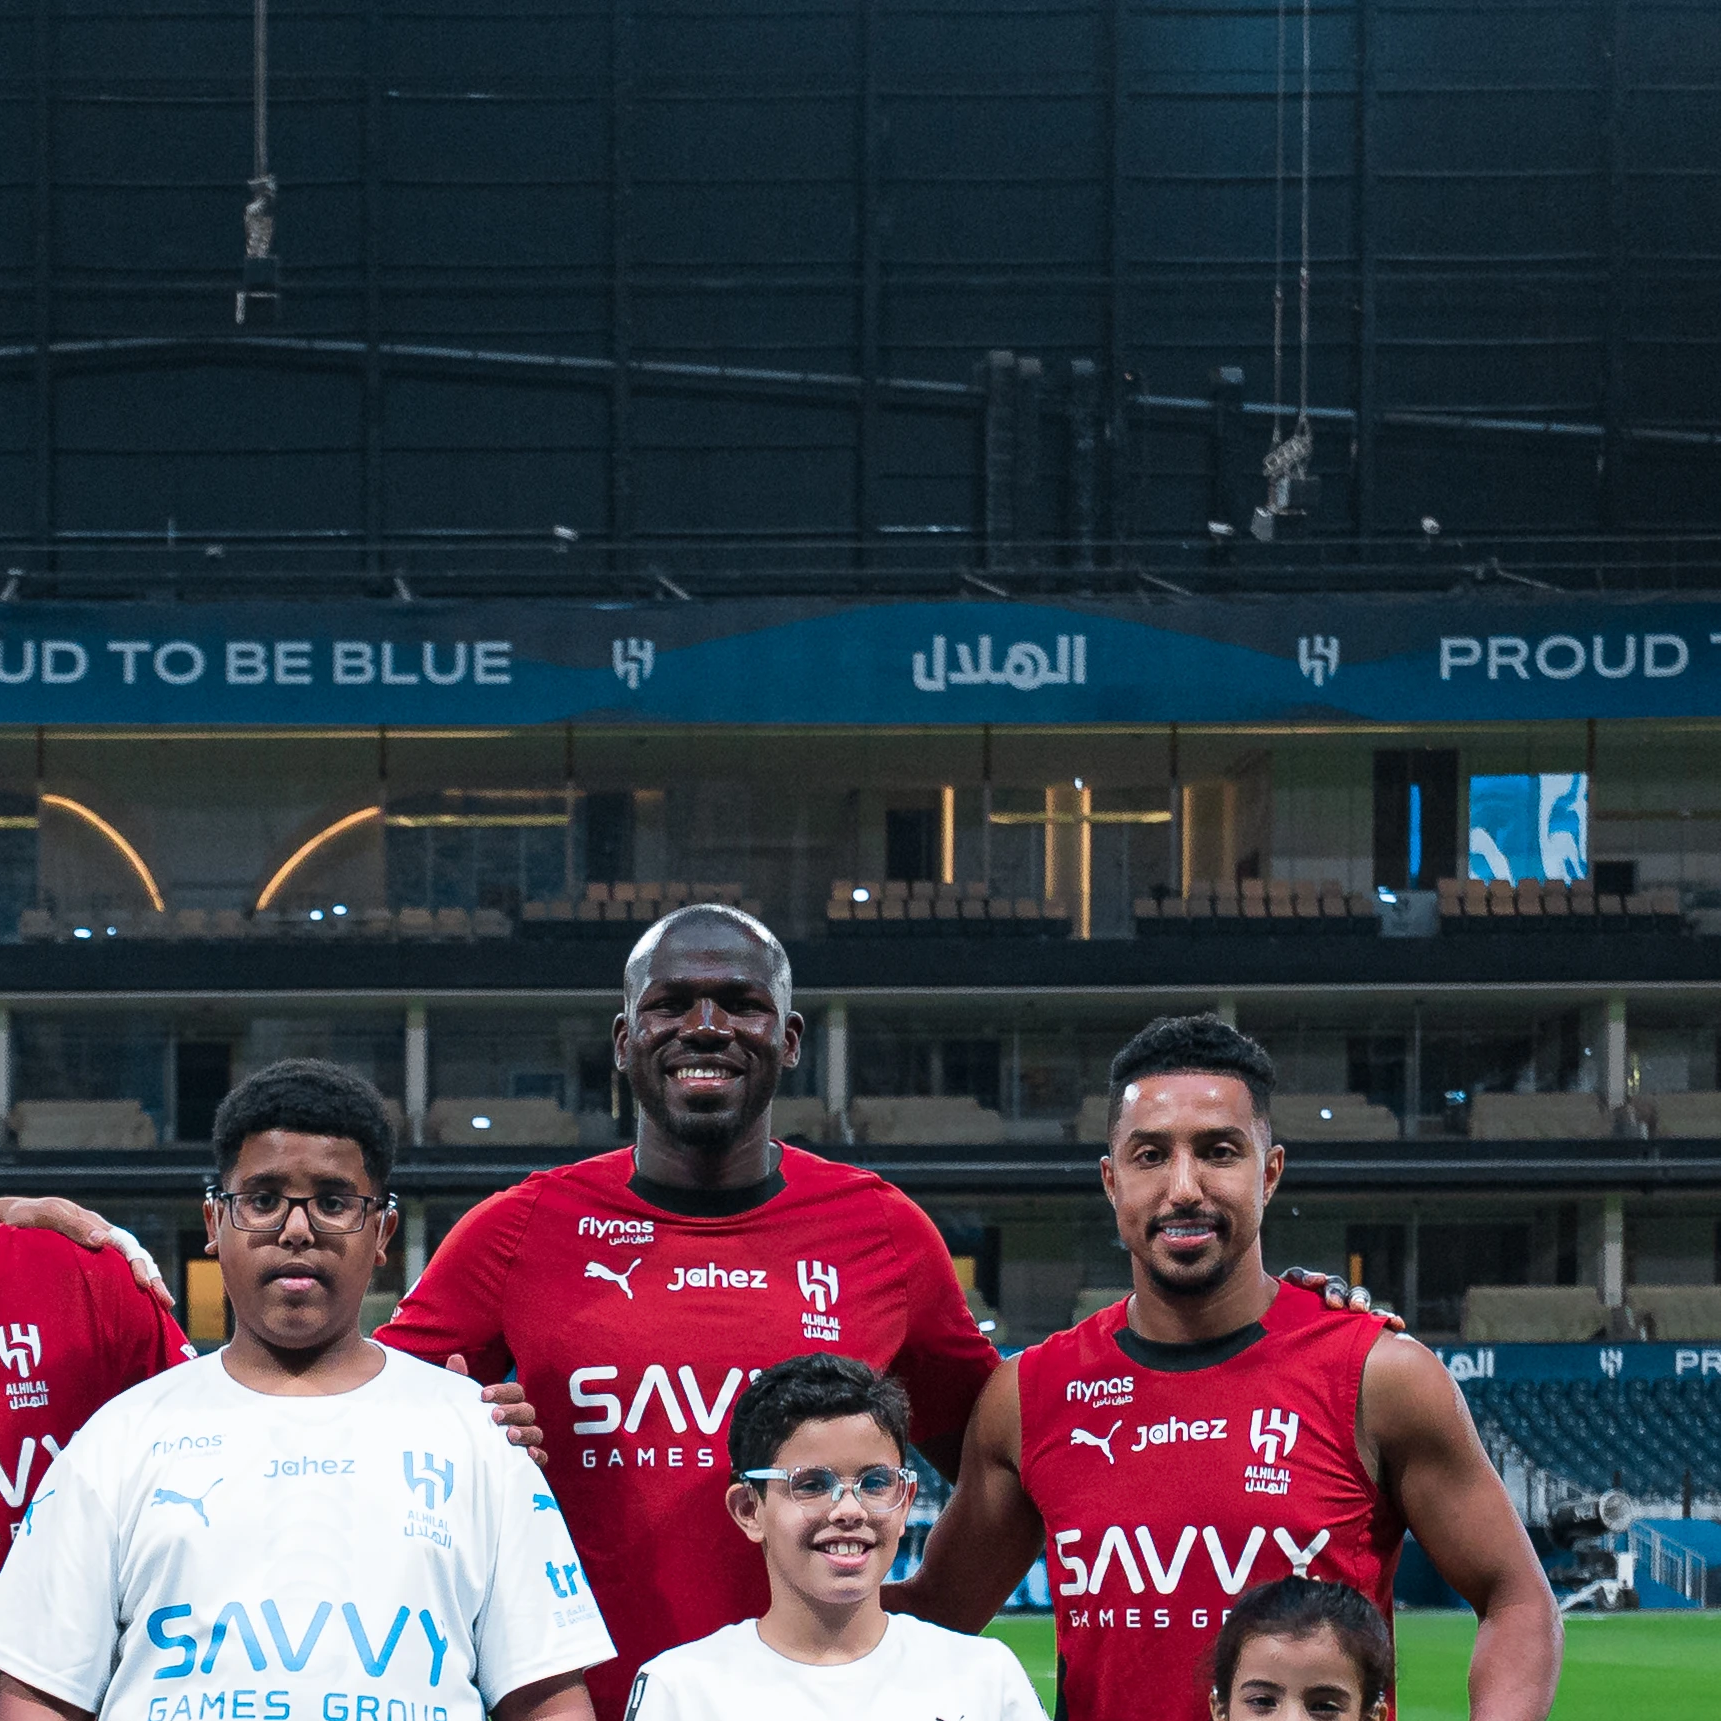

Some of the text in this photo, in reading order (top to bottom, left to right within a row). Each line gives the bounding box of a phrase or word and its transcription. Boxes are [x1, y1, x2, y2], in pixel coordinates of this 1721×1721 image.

[106, 639, 207, 686] TO
[225, 639, 314, 686] BE
[332, 639, 514, 686] BLUE
[912, 633, 1088, 693] الهلال
[1439, 632, 1690, 682] PROUD
[577, 1216, 655, 1239] flynas
[801, 1312, 841, 1330] ALHILAL
[5, 1381, 49, 1397] ALHILAL
[568, 1363, 762, 1436] SAV
[1066, 1376, 1135, 1403] flynas
[583, 1446, 715, 1469] GAMES
[1244, 1465, 1292, 1484] ALHILAL
[406, 1510, 450, 1533] ALHILAL
[1054, 1524, 1331, 1597] SAVVY
[1069, 1608, 1171, 1629] GAMES
[146, 1598, 449, 1688] SAVVY
